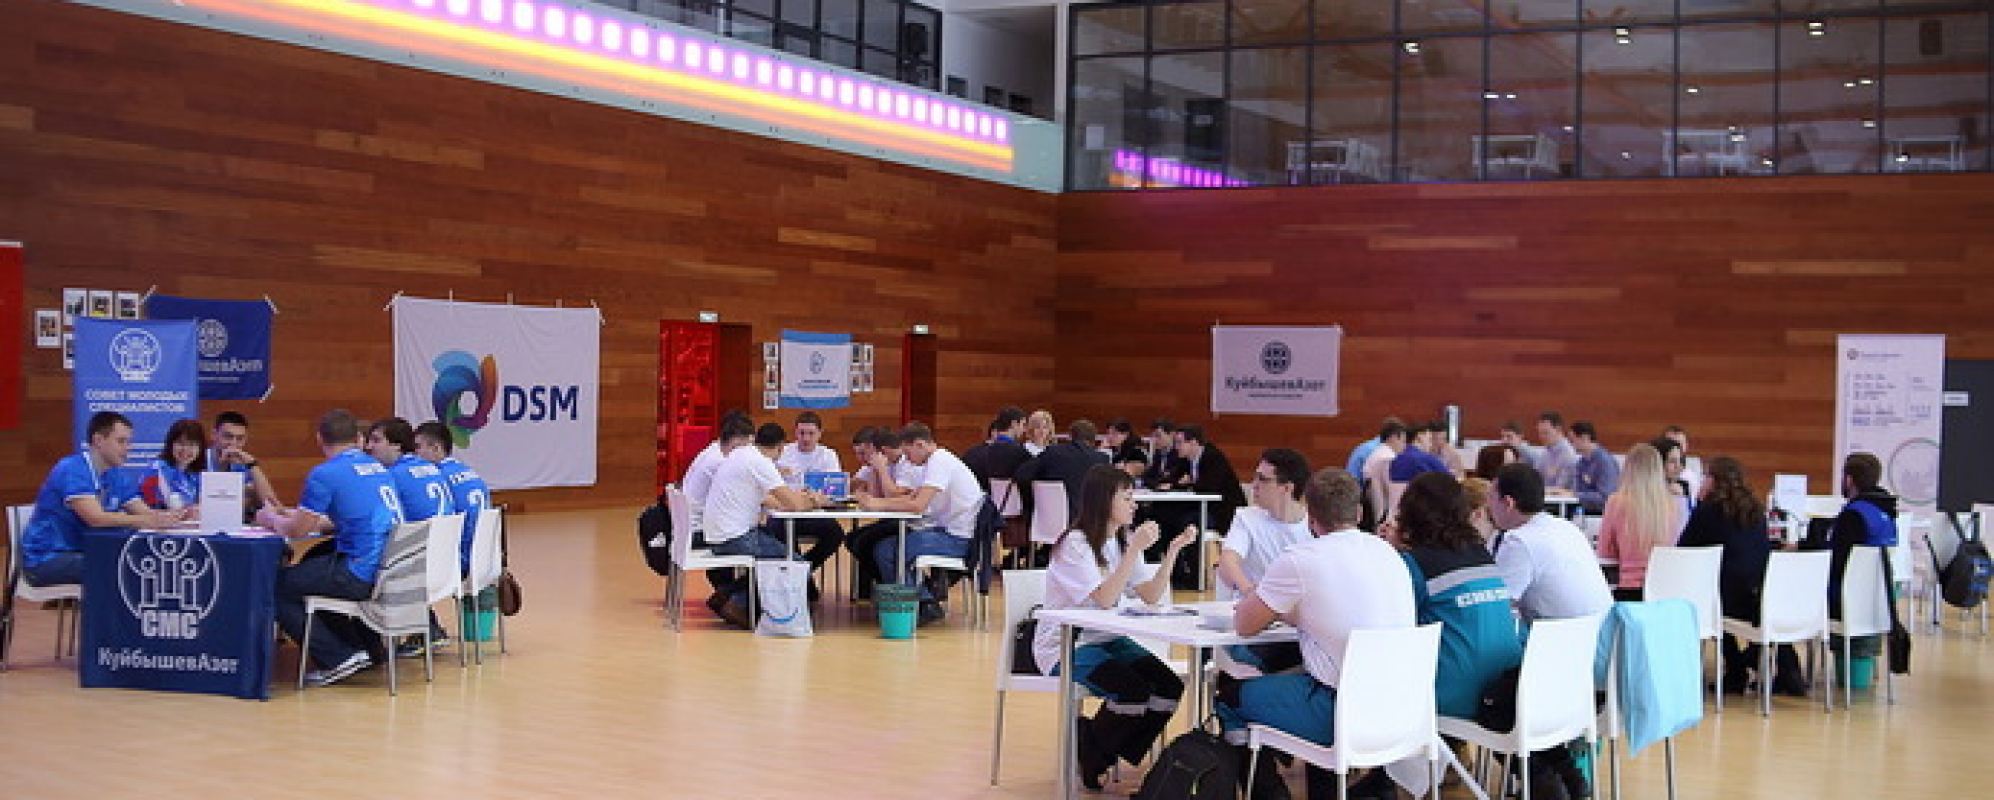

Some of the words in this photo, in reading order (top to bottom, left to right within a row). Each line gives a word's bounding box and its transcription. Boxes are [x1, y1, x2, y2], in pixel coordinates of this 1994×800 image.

[1225, 375, 1325, 391] КуйбышевАзот
[503, 385, 578, 421] DSM
[142, 611, 198, 638] СМС
[98, 648, 239, 673] КуйбышевАзот
